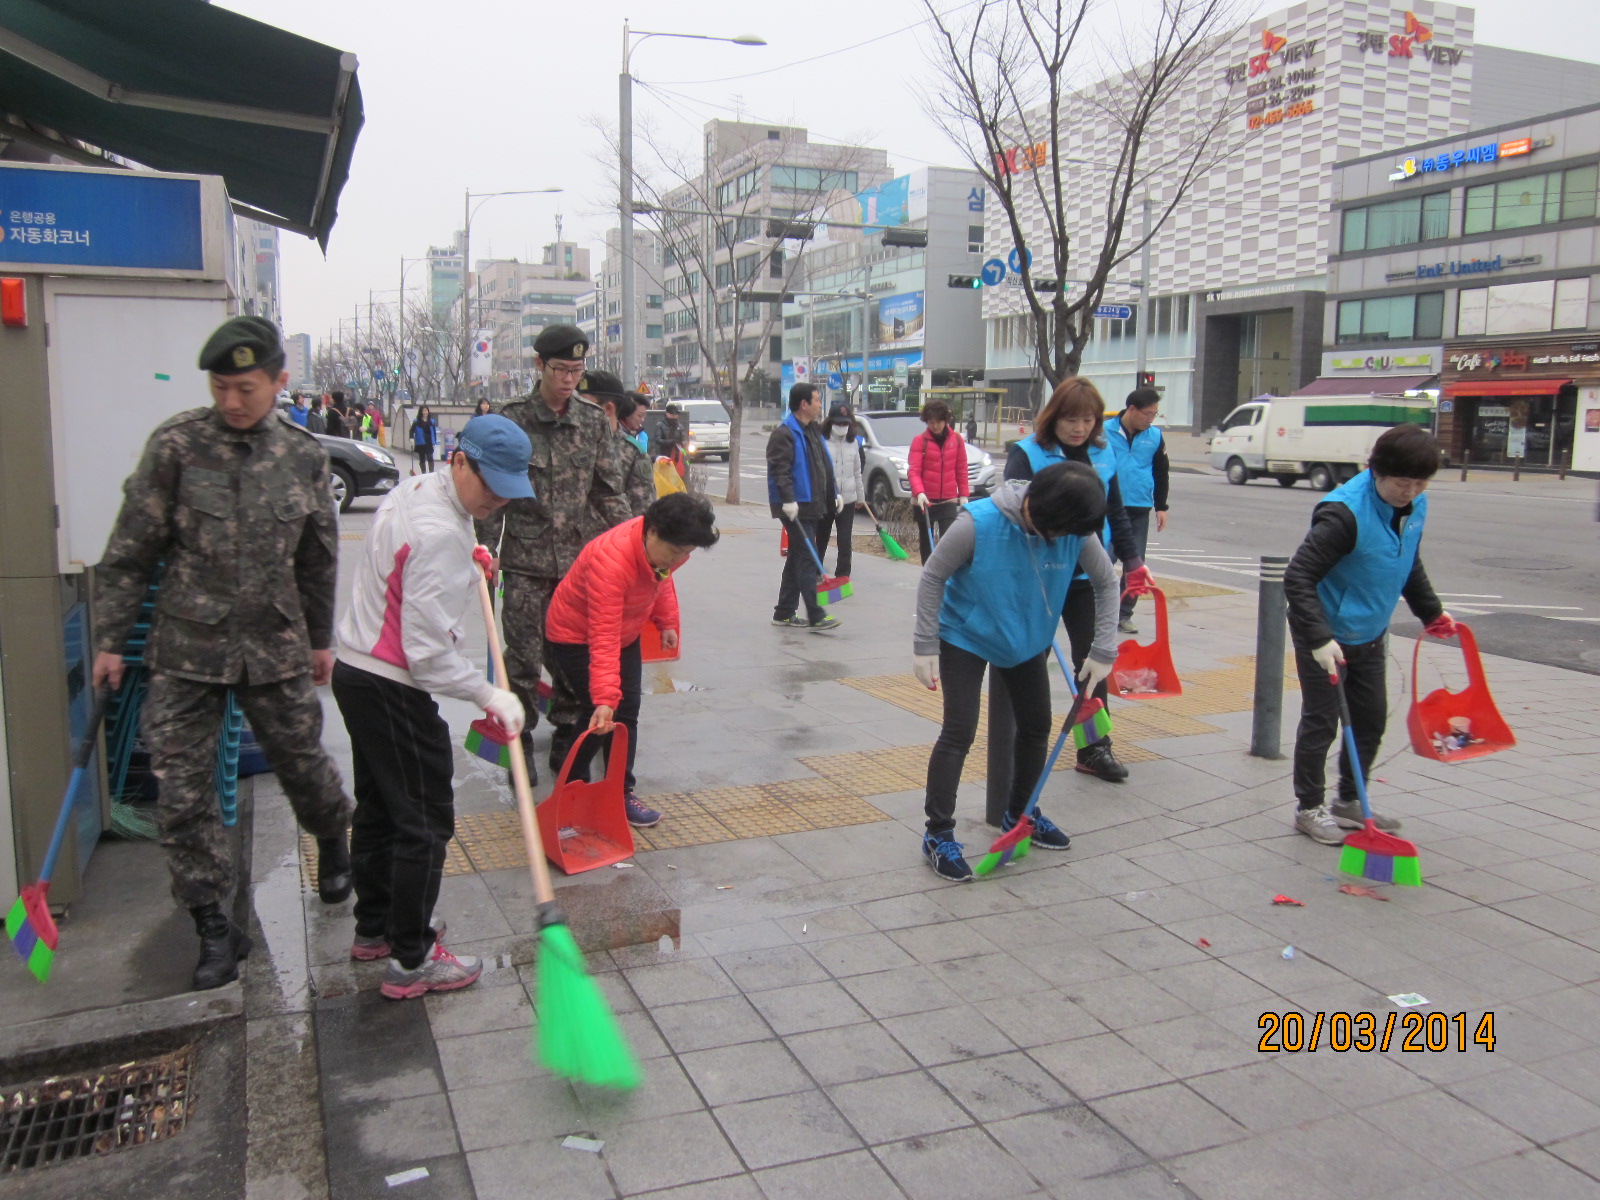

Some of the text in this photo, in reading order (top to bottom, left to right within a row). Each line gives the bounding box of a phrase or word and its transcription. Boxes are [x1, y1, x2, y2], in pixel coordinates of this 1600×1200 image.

[1248, 51, 1270, 77] SK
[1280, 39, 1318, 66] VIEW
[1388, 34, 1414, 59] SK
[1423, 43, 1464, 66] VIEW
[10, 210, 57, 225] 은행공용
[10, 227, 90, 247] 자동화코너
[1450, 254, 1502, 275] United
